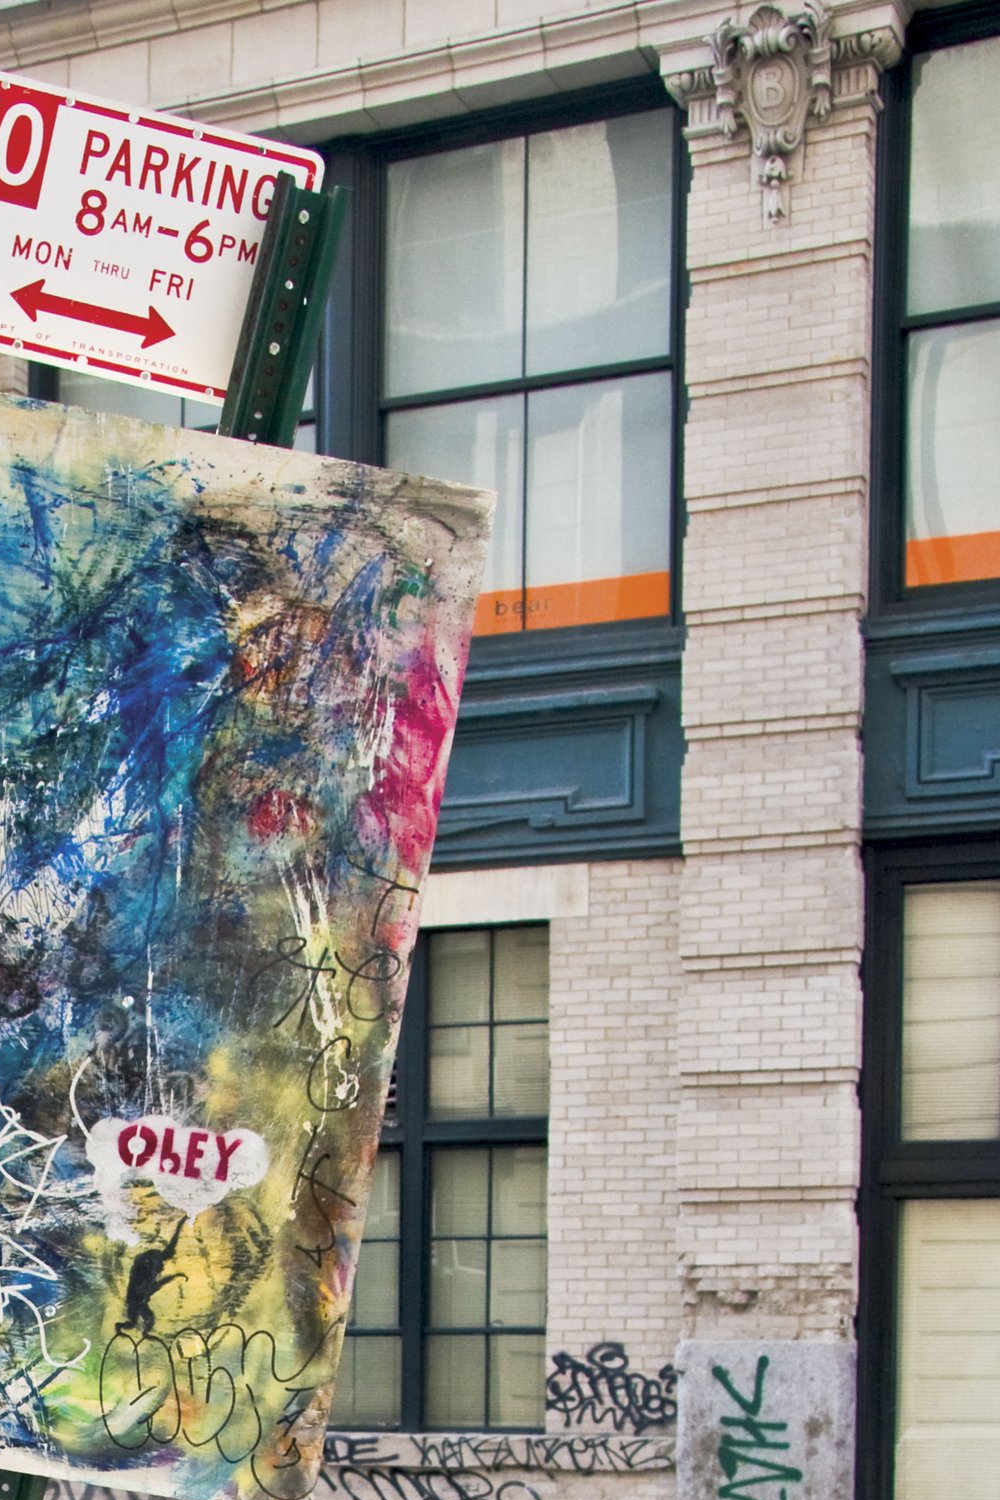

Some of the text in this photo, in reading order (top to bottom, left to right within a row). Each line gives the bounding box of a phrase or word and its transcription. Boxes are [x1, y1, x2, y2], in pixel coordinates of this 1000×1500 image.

[80, 129, 280, 222] PARKING
[75, 189, 258, 264] 8AM-6PM
[11, 235, 195, 302] MON THRU FRI
[35, 331, 52, 342] OF
[71, 340, 190, 376] TRANSPORTATION
